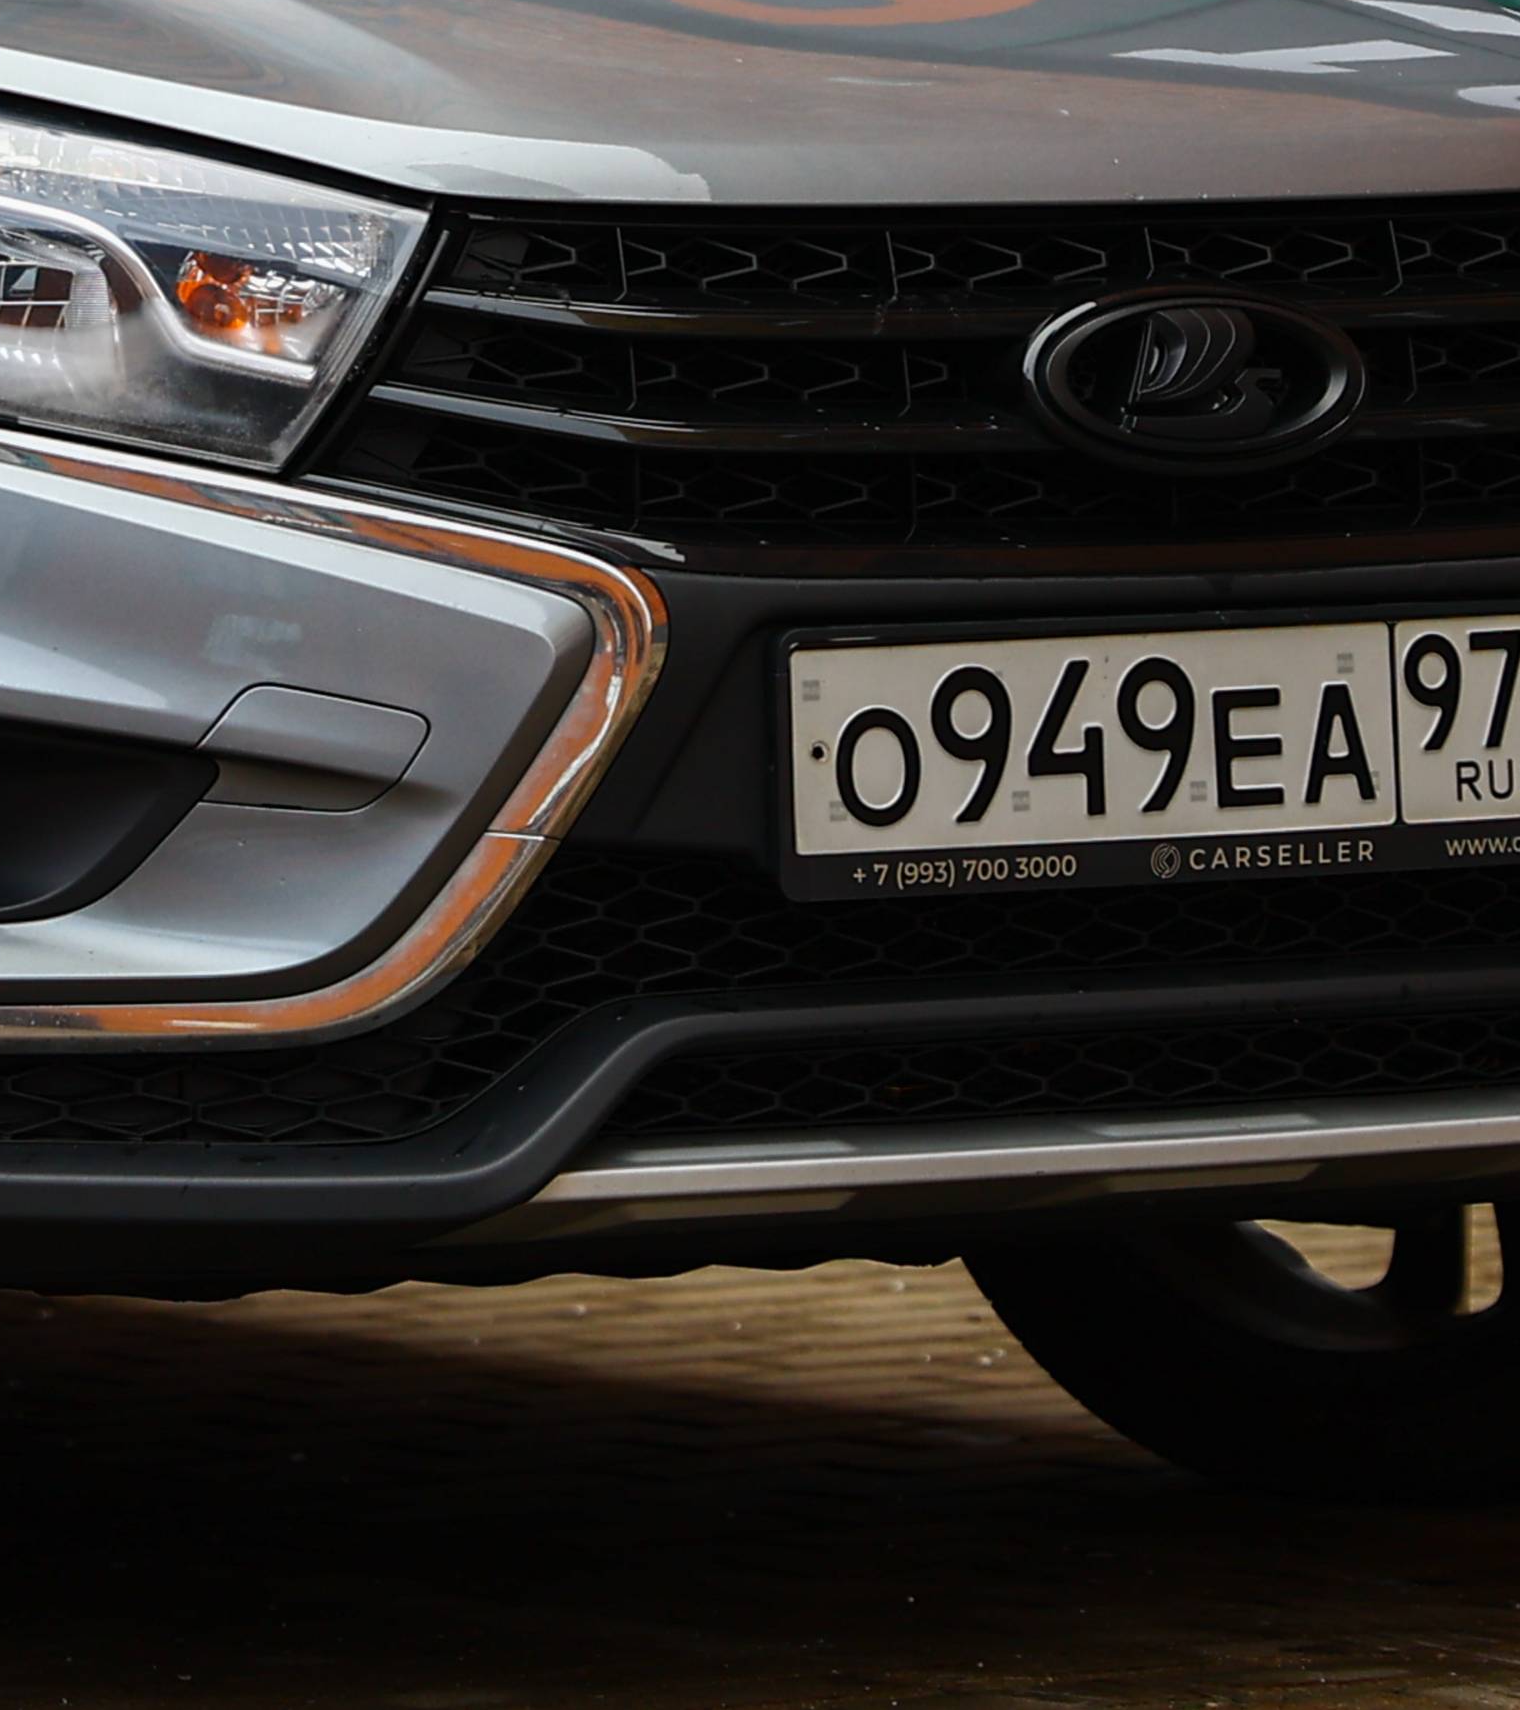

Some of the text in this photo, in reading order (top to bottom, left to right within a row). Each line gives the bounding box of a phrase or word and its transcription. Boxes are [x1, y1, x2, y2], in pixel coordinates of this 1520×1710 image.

[1189, 840, 1375, 871] CARSELLER
[873, 863, 889, 886] 7
[896, 859, 956, 890] (993)
[962, 858, 1009, 882] 700
[1014, 855, 1078, 880] 3000
